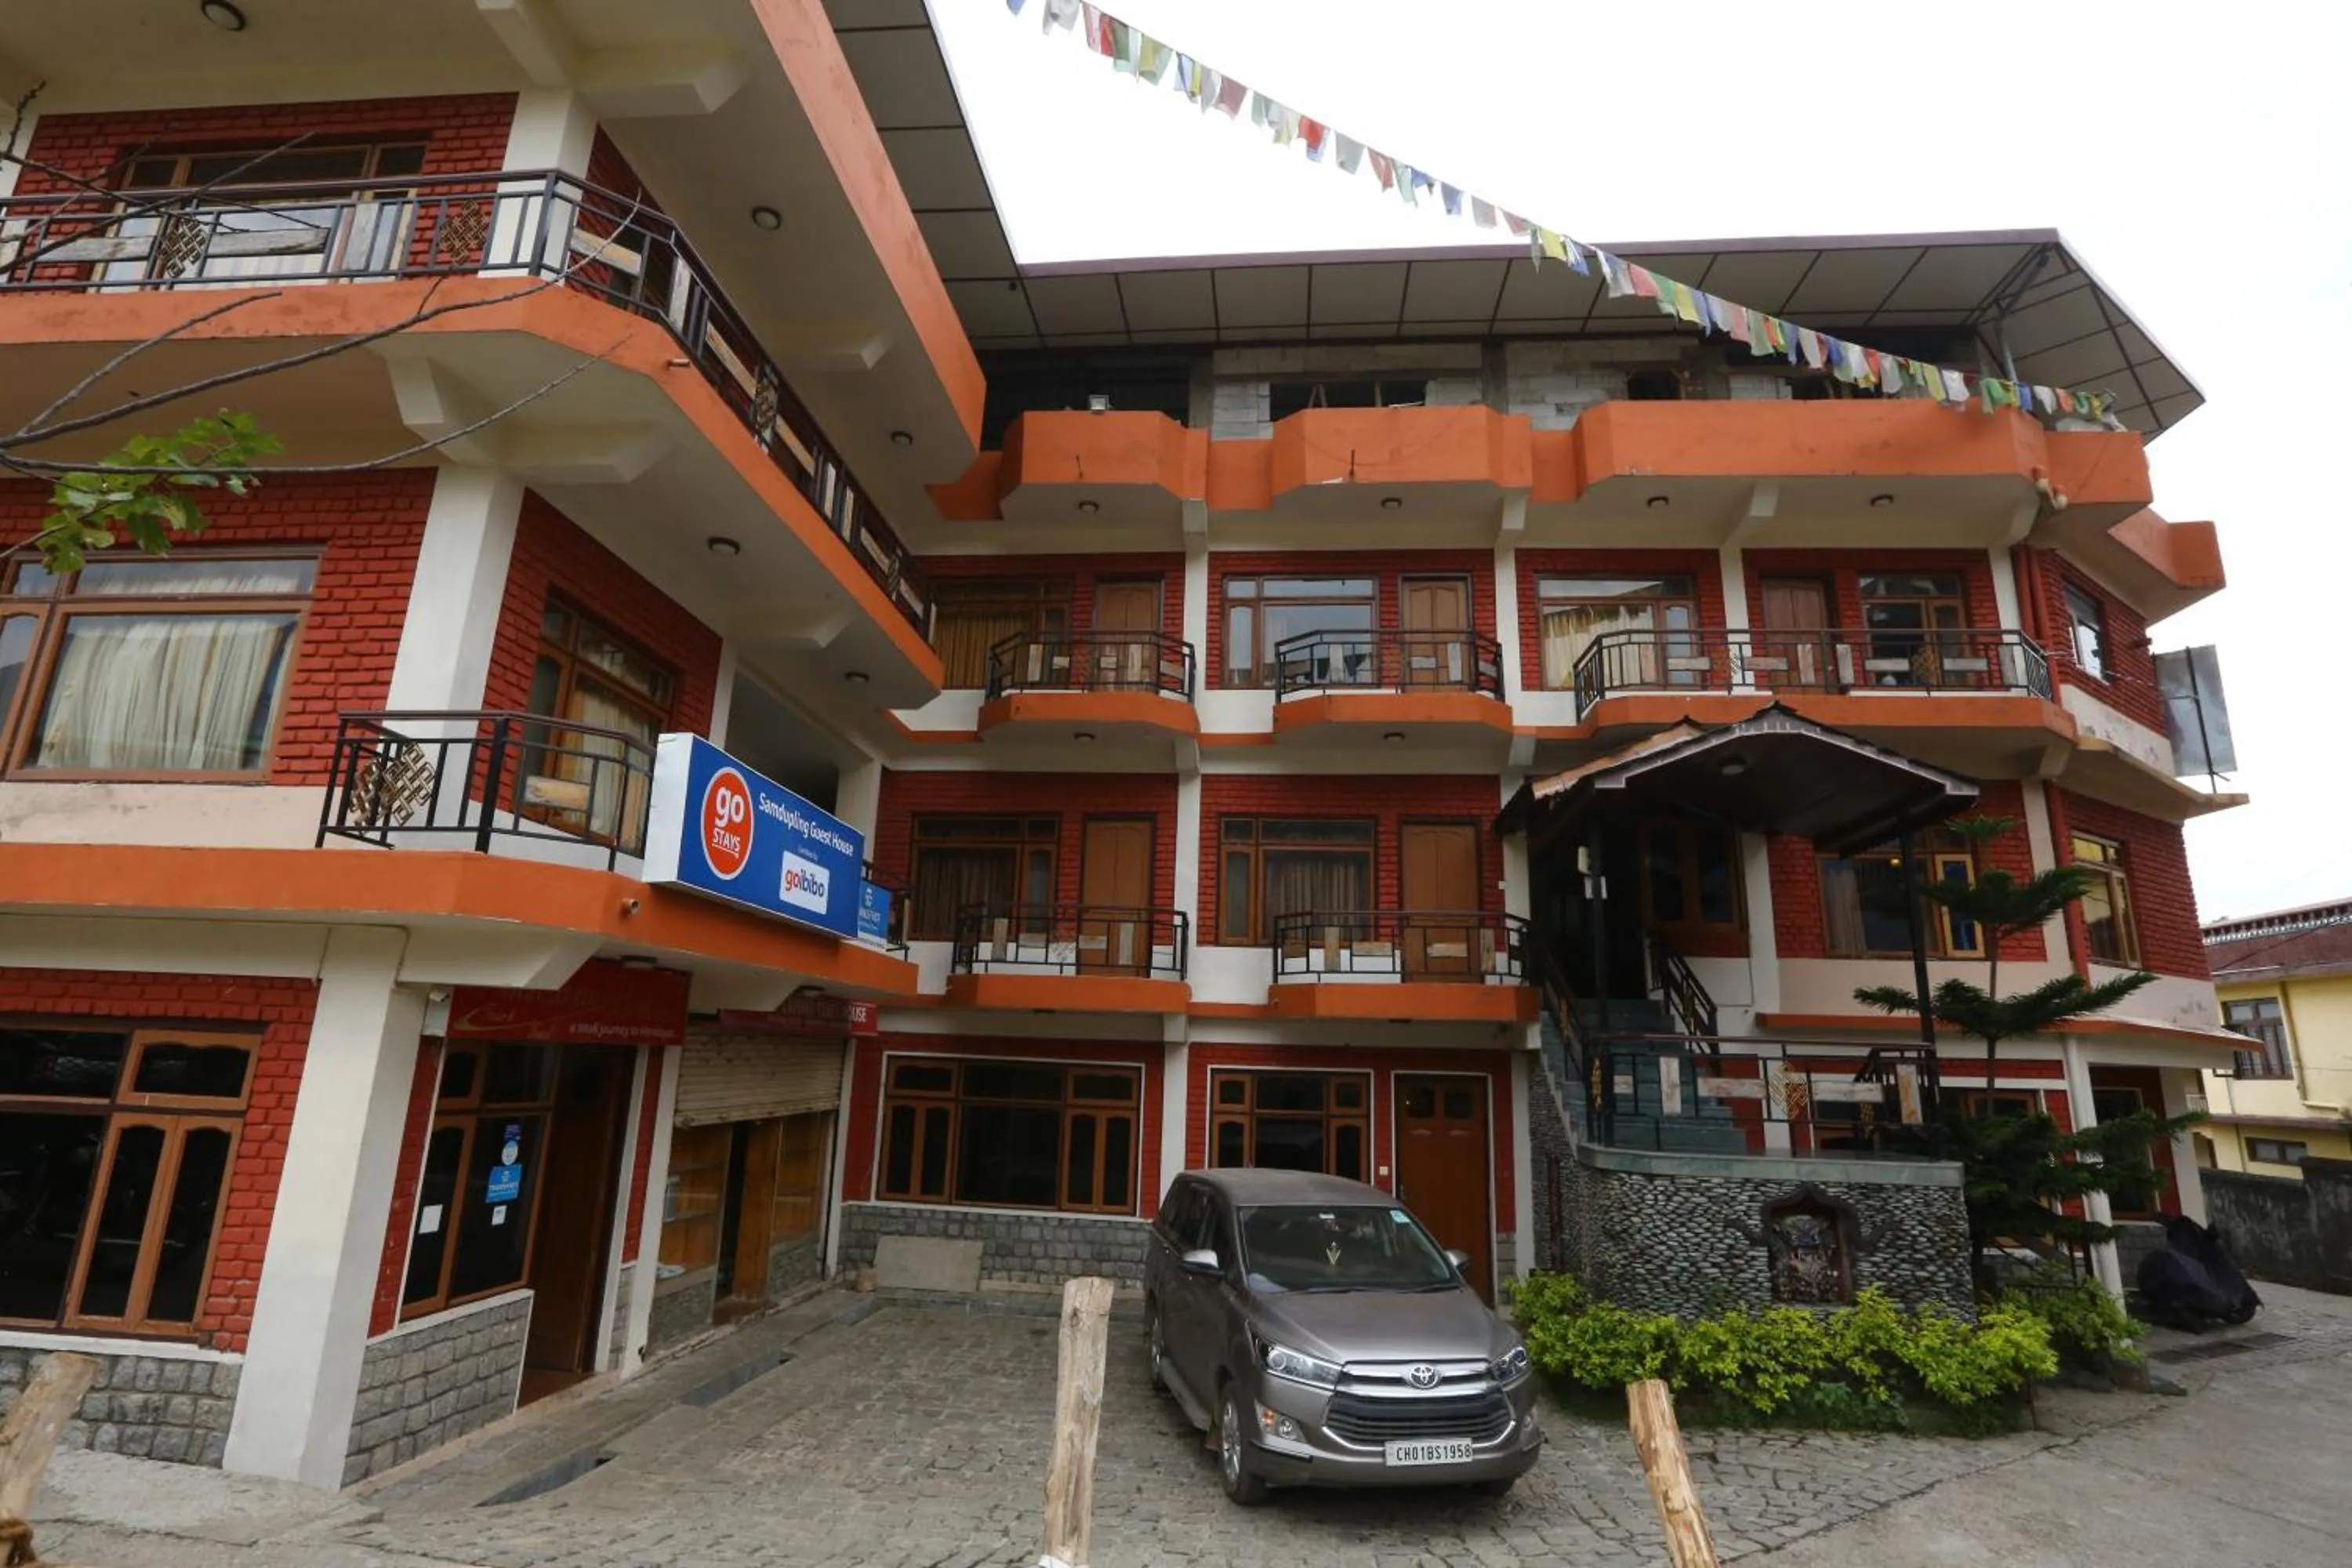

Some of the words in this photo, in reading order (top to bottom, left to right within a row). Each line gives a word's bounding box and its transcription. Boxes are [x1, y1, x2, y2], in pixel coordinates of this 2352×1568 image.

[714, 786, 745, 828] go
[713, 827, 741, 852] STAYS
[810, 821, 832, 848] Guest
[832, 832, 854, 857] House
[785, 869, 826, 898] goibibo
[1396, 1443, 1472, 1461] CH01BS1958
